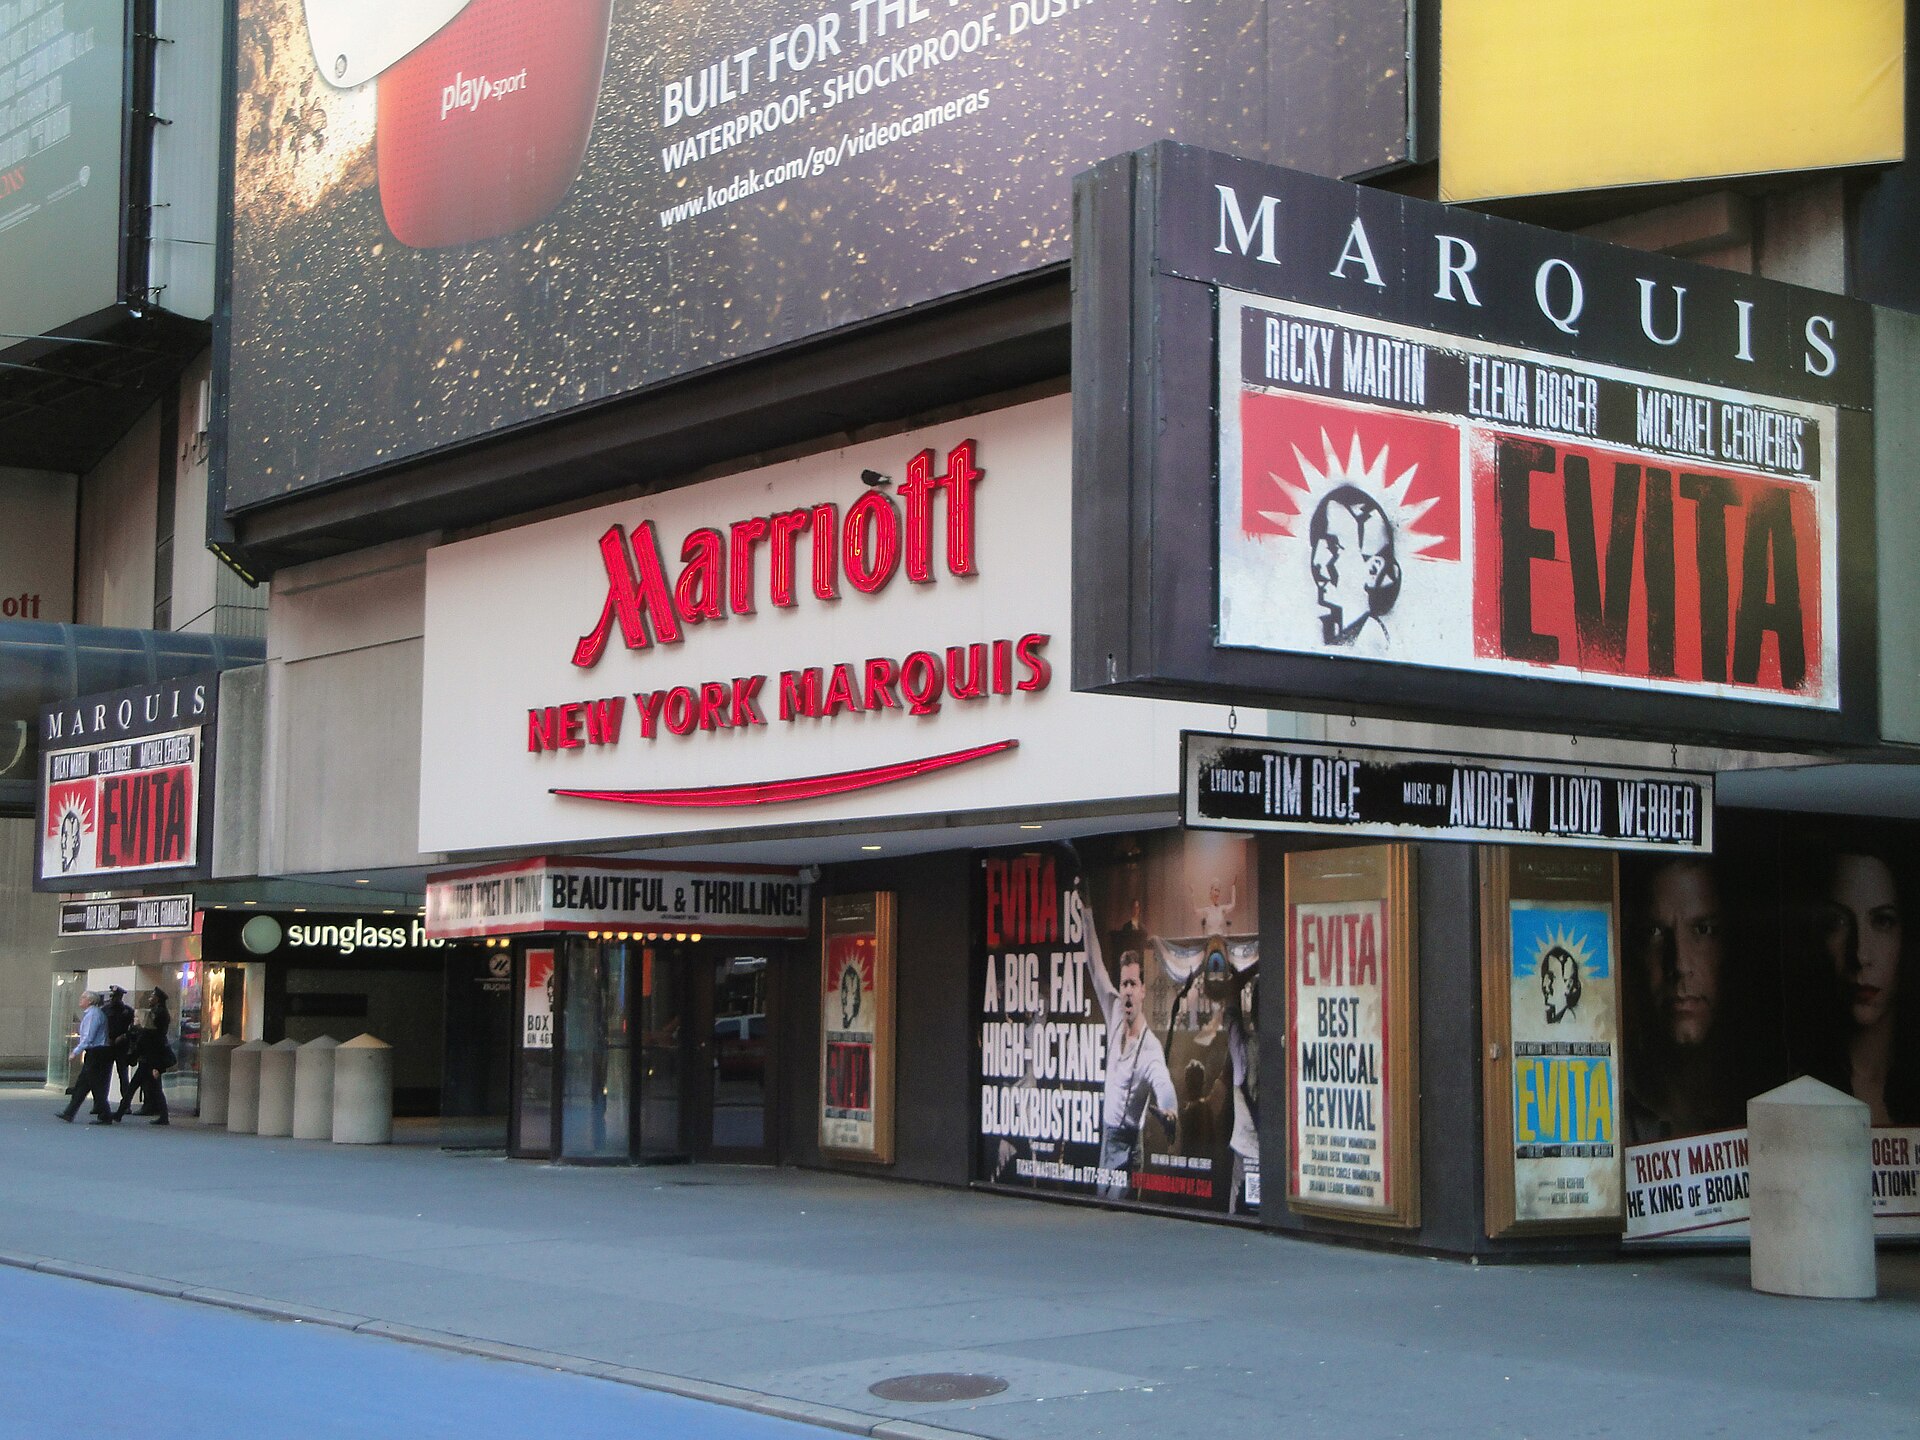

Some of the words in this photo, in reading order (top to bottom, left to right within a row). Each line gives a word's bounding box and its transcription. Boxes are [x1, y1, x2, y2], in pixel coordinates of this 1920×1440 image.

[661, 88, 817, 174] WATERPROOF.
[822, 12, 1002, 109] SHOCKPROOF.
[663, 46, 758, 128] BUILT
[768, 12, 842, 83] FOR
[850, 0, 930, 45] THE
[659, 88, 990, 228] www.kodak.com/go/videocameras
[1213, 183, 1837, 377] MARQUIS
[1265, 316, 1335, 389] RICKY
[1342, 329, 1426, 406] MARTIN
[1468, 355, 1529, 426] ELENA
[1535, 364, 1599, 436] ROGER
[1636, 386, 1715, 457] MICHAEL
[1720, 403, 1804, 472] CERVERIS
[570, 437, 986, 669] Marriott
[1499, 441, 1806, 691] EVITA
[48, 685, 207, 740] MARQUIS
[528, 696, 626, 754] NEW
[635, 674, 767, 740] YORK
[779, 632, 1051, 721] MARQUIS
[102, 769, 186, 867] EVITA
[1211, 768, 1245, 794] LYRICS
[1249, 771, 1261, 794] BY
[1262, 754, 1301, 816] TIM
[1312, 757, 1360, 819] RICE
[1403, 781, 1431, 805] MUSIC
[1436, 783, 1447, 806] BY
[1450, 768, 1534, 830] ANDREW
[1550, 775, 1602, 834] LLOYD
[1617, 780, 1694, 840] WEBBER
[674, 887, 685, 913] &
[1063, 889, 1083, 945] IS
[288, 918, 407, 955] sunglass
[1302, 913, 1377, 987] EVITA
[984, 954, 998, 1013] A
[1005, 952, 1044, 1016] BIG,
[1050, 951, 1091, 1017] FAT,
[527, 1015, 549, 1031] BOX
[1317, 997, 1359, 1039] BEST
[981, 1022, 1105, 1082] HIGH-OCTANE
[1302, 1042, 1378, 1085] MUSICAL
[1306, 1086, 1376, 1132] REVIVAL
[1516, 1059, 1611, 1141] EVITA
[1687, 1138, 1749, 1175] MARTIN
[1872, 1137, 1909, 1165] OGER
[1627, 1189, 1646, 1218] HE
[1648, 1183, 1684, 1214] KING
[1688, 1185, 1701, 1208] OF
